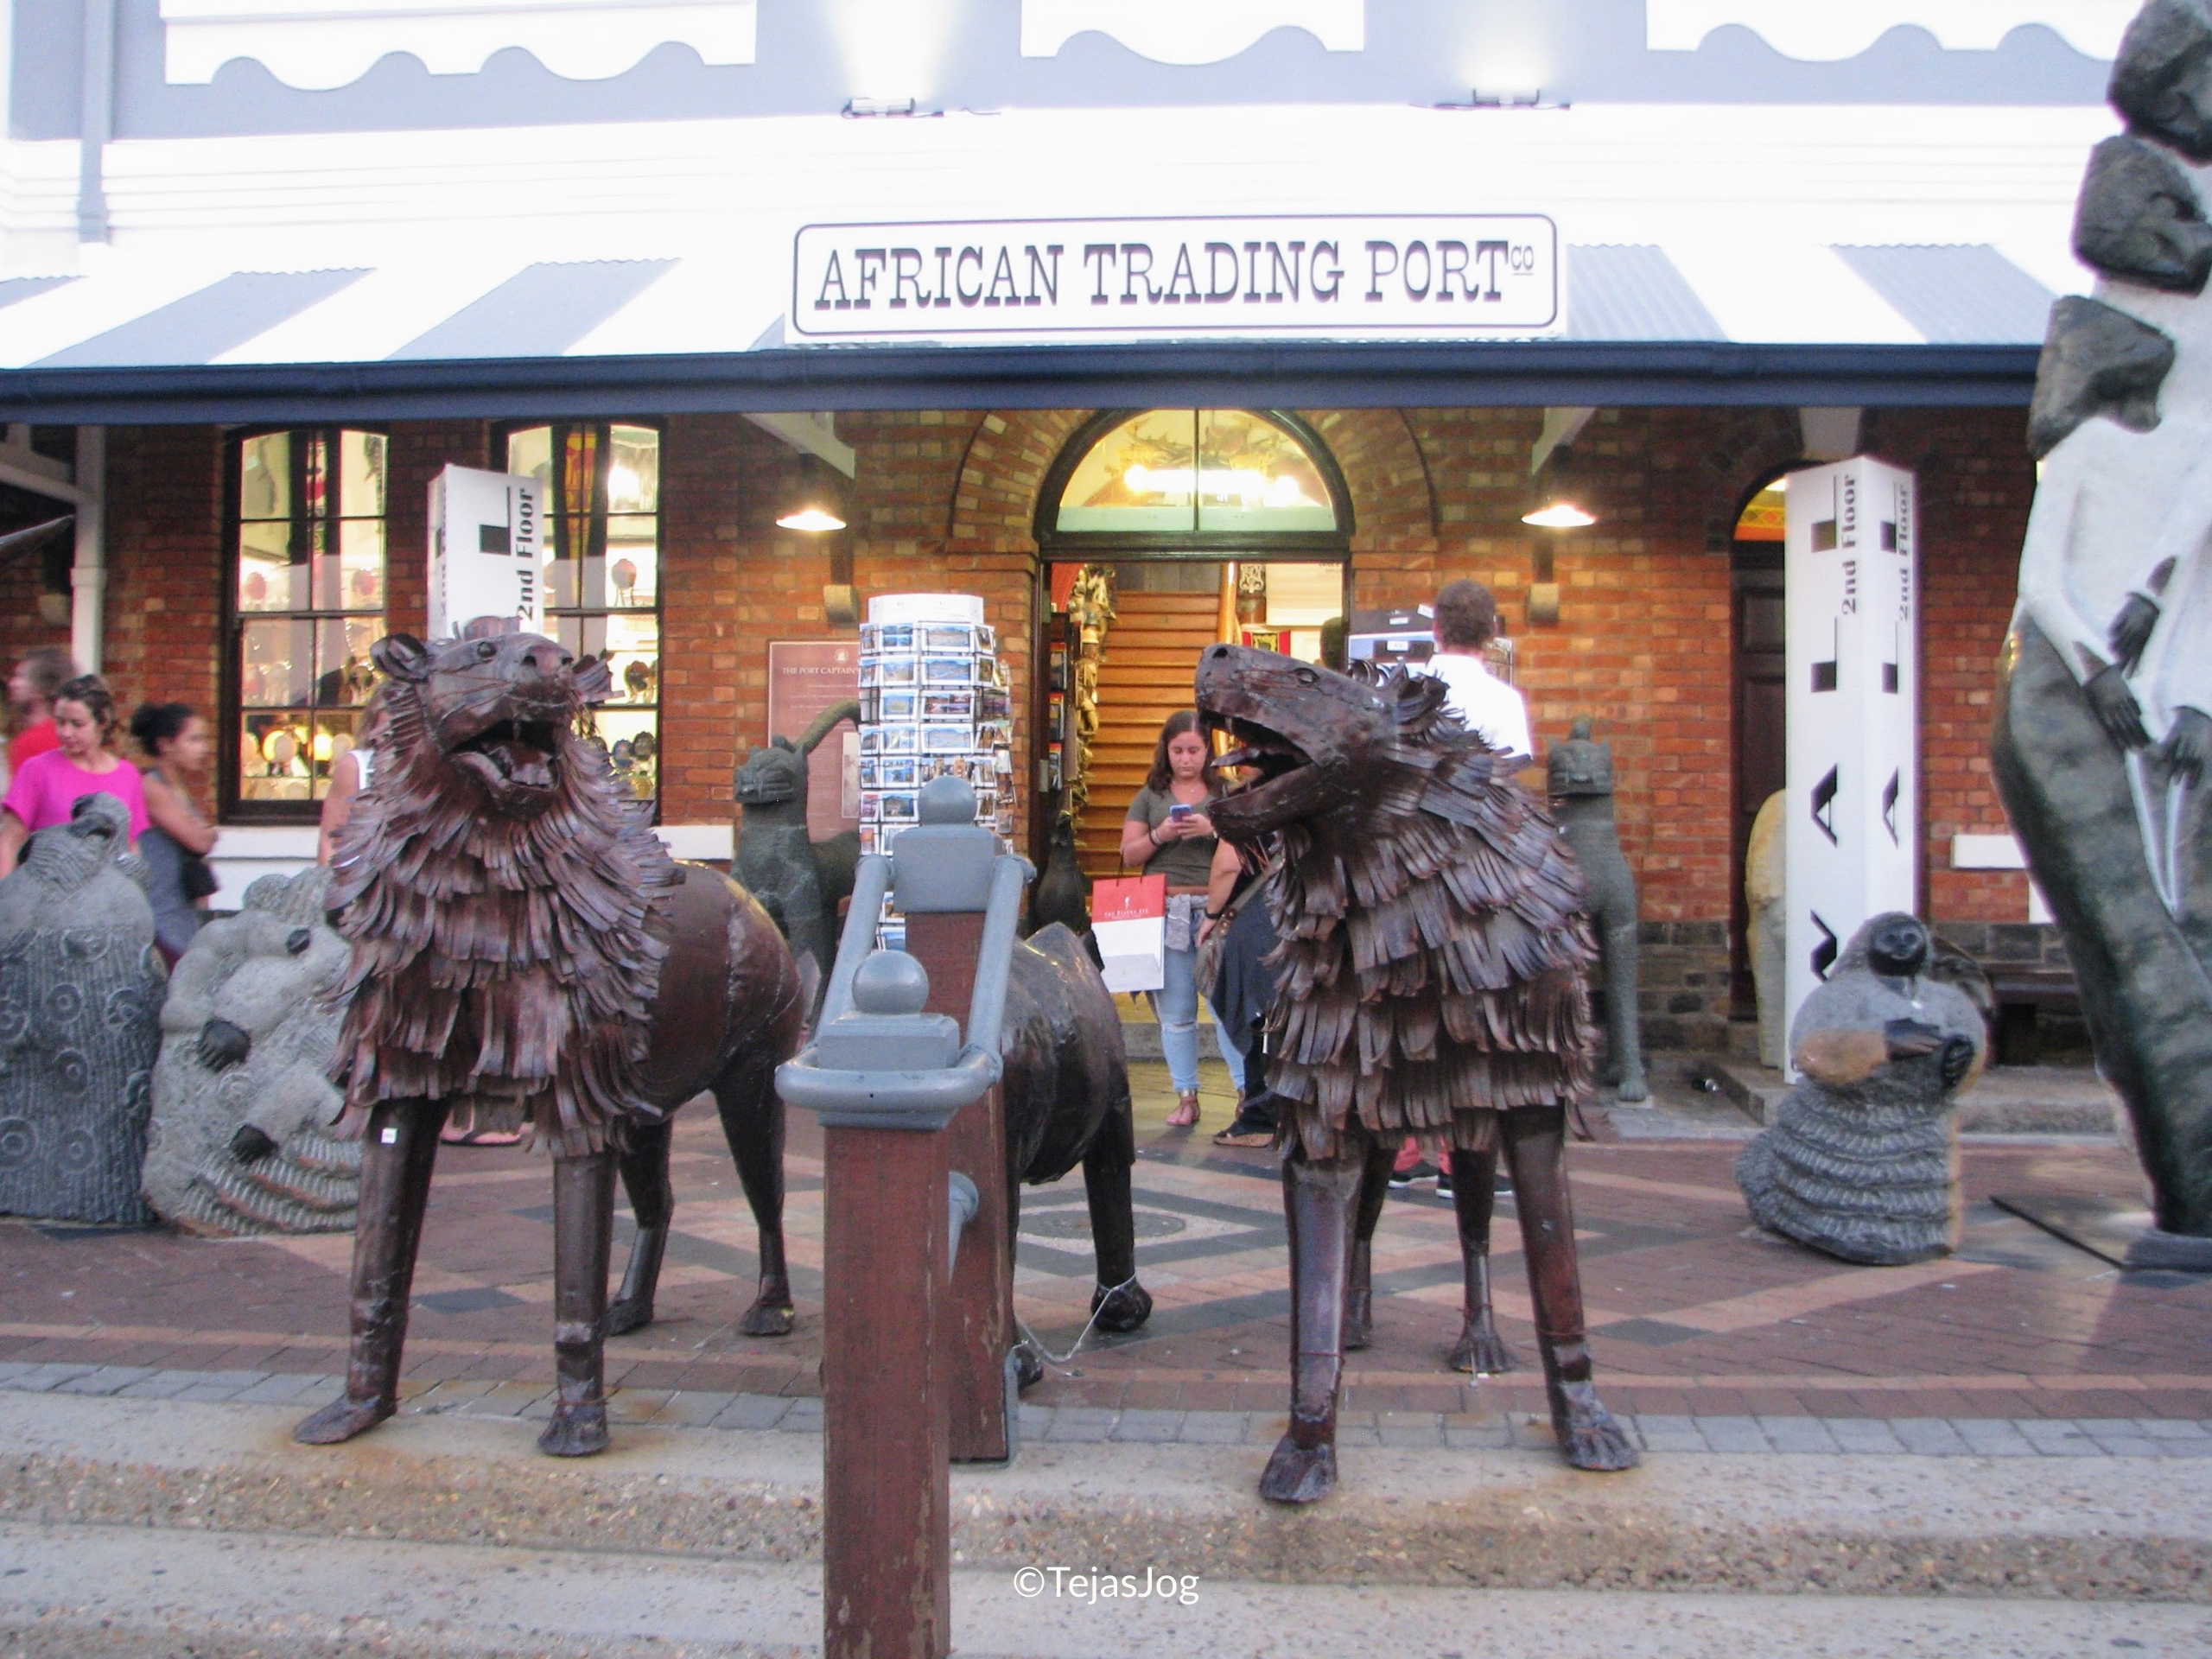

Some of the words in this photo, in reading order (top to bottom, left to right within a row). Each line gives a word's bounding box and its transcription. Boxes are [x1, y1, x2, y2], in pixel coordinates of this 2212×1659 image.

[814, 245, 1065, 310] AFRICAN
[1084, 241, 1345, 305] TRADING
[1365, 239, 1510, 302] PORT
[516, 488, 533, 558] Floor
[1841, 474, 1855, 549] Floor
[517, 570, 533, 620] 2nd
[1841, 561, 1856, 615] 2nd
